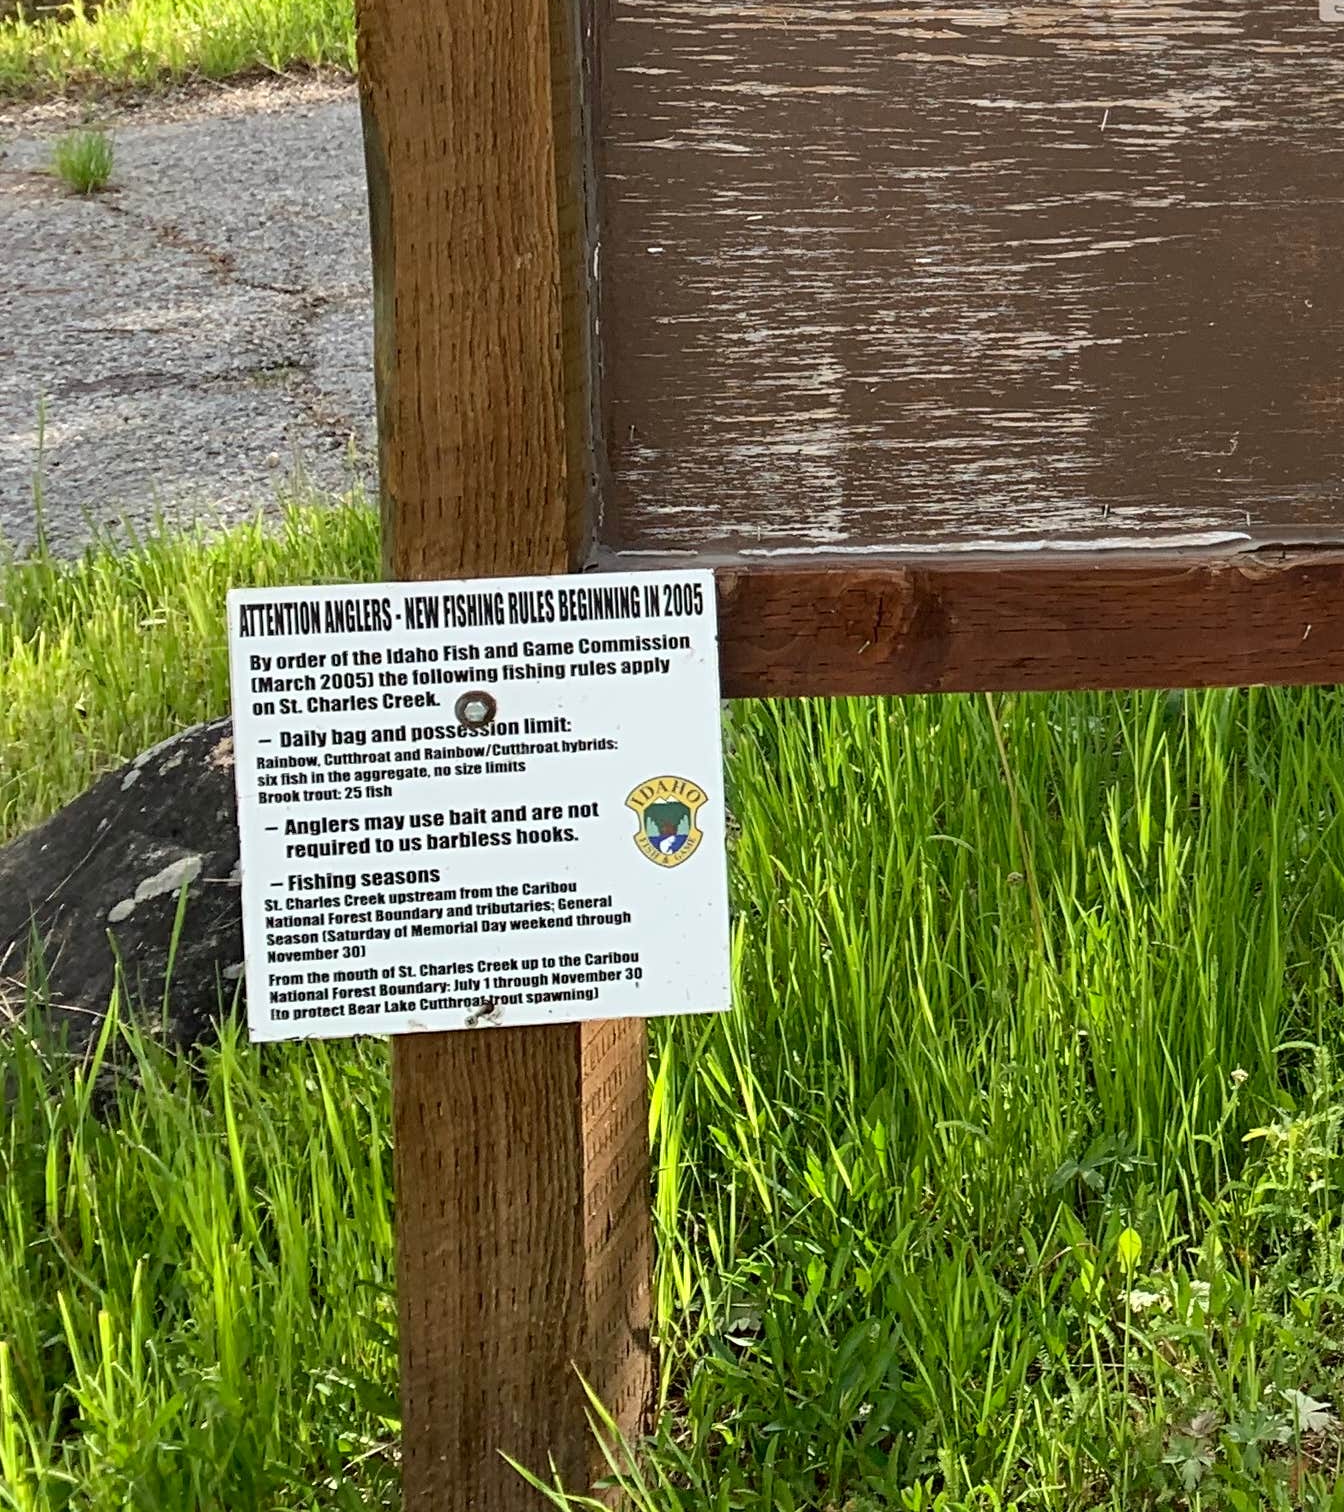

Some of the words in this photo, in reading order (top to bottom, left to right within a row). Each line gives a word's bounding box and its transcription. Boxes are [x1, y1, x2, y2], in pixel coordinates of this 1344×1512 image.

[239, 600, 321, 638] ATTENTION
[325, 597, 393, 634] ANGLERS
[404, 595, 439, 630] NEW
[443, 592, 504, 629] FISHING
[508, 589, 555, 625] RULES
[558, 585, 640, 622] BEGINNING
[644, 584, 660, 618] IN
[663, 582, 704, 617] 2005
[249, 655, 272, 673] By
[277, 652, 327, 670] order
[331, 650, 349, 667] of
[352, 649, 383, 666] the
[386, 647, 439, 665] Idaho
[443, 644, 481, 662] Fish
[484, 642, 519, 660] and
[523, 640, 575, 658] Game
[578, 634, 691, 656] Commission
[251, 675, 317, 694] (March
[320, 672, 375, 692] 2005)
[378, 669, 409, 687] the
[412, 666, 499, 688] following
[502, 662, 567, 682] fishing
[570, 660, 617, 678] rules
[620, 657, 671, 675] apply
[252, 701, 275, 717] on
[279, 697, 303, 715] St.
[306, 695, 379, 714] Charles
[383, 690, 441, 710] Creek.
[258, 789, 301, 805] Brook
[303, 788, 342, 802] trout:
[344, 786, 363, 800] 25
[365, 784, 393, 799] fish
[631, 780, 702, 807] IDAHO
[287, 872, 357, 892] Fishing
[361, 868, 441, 887] seasons
